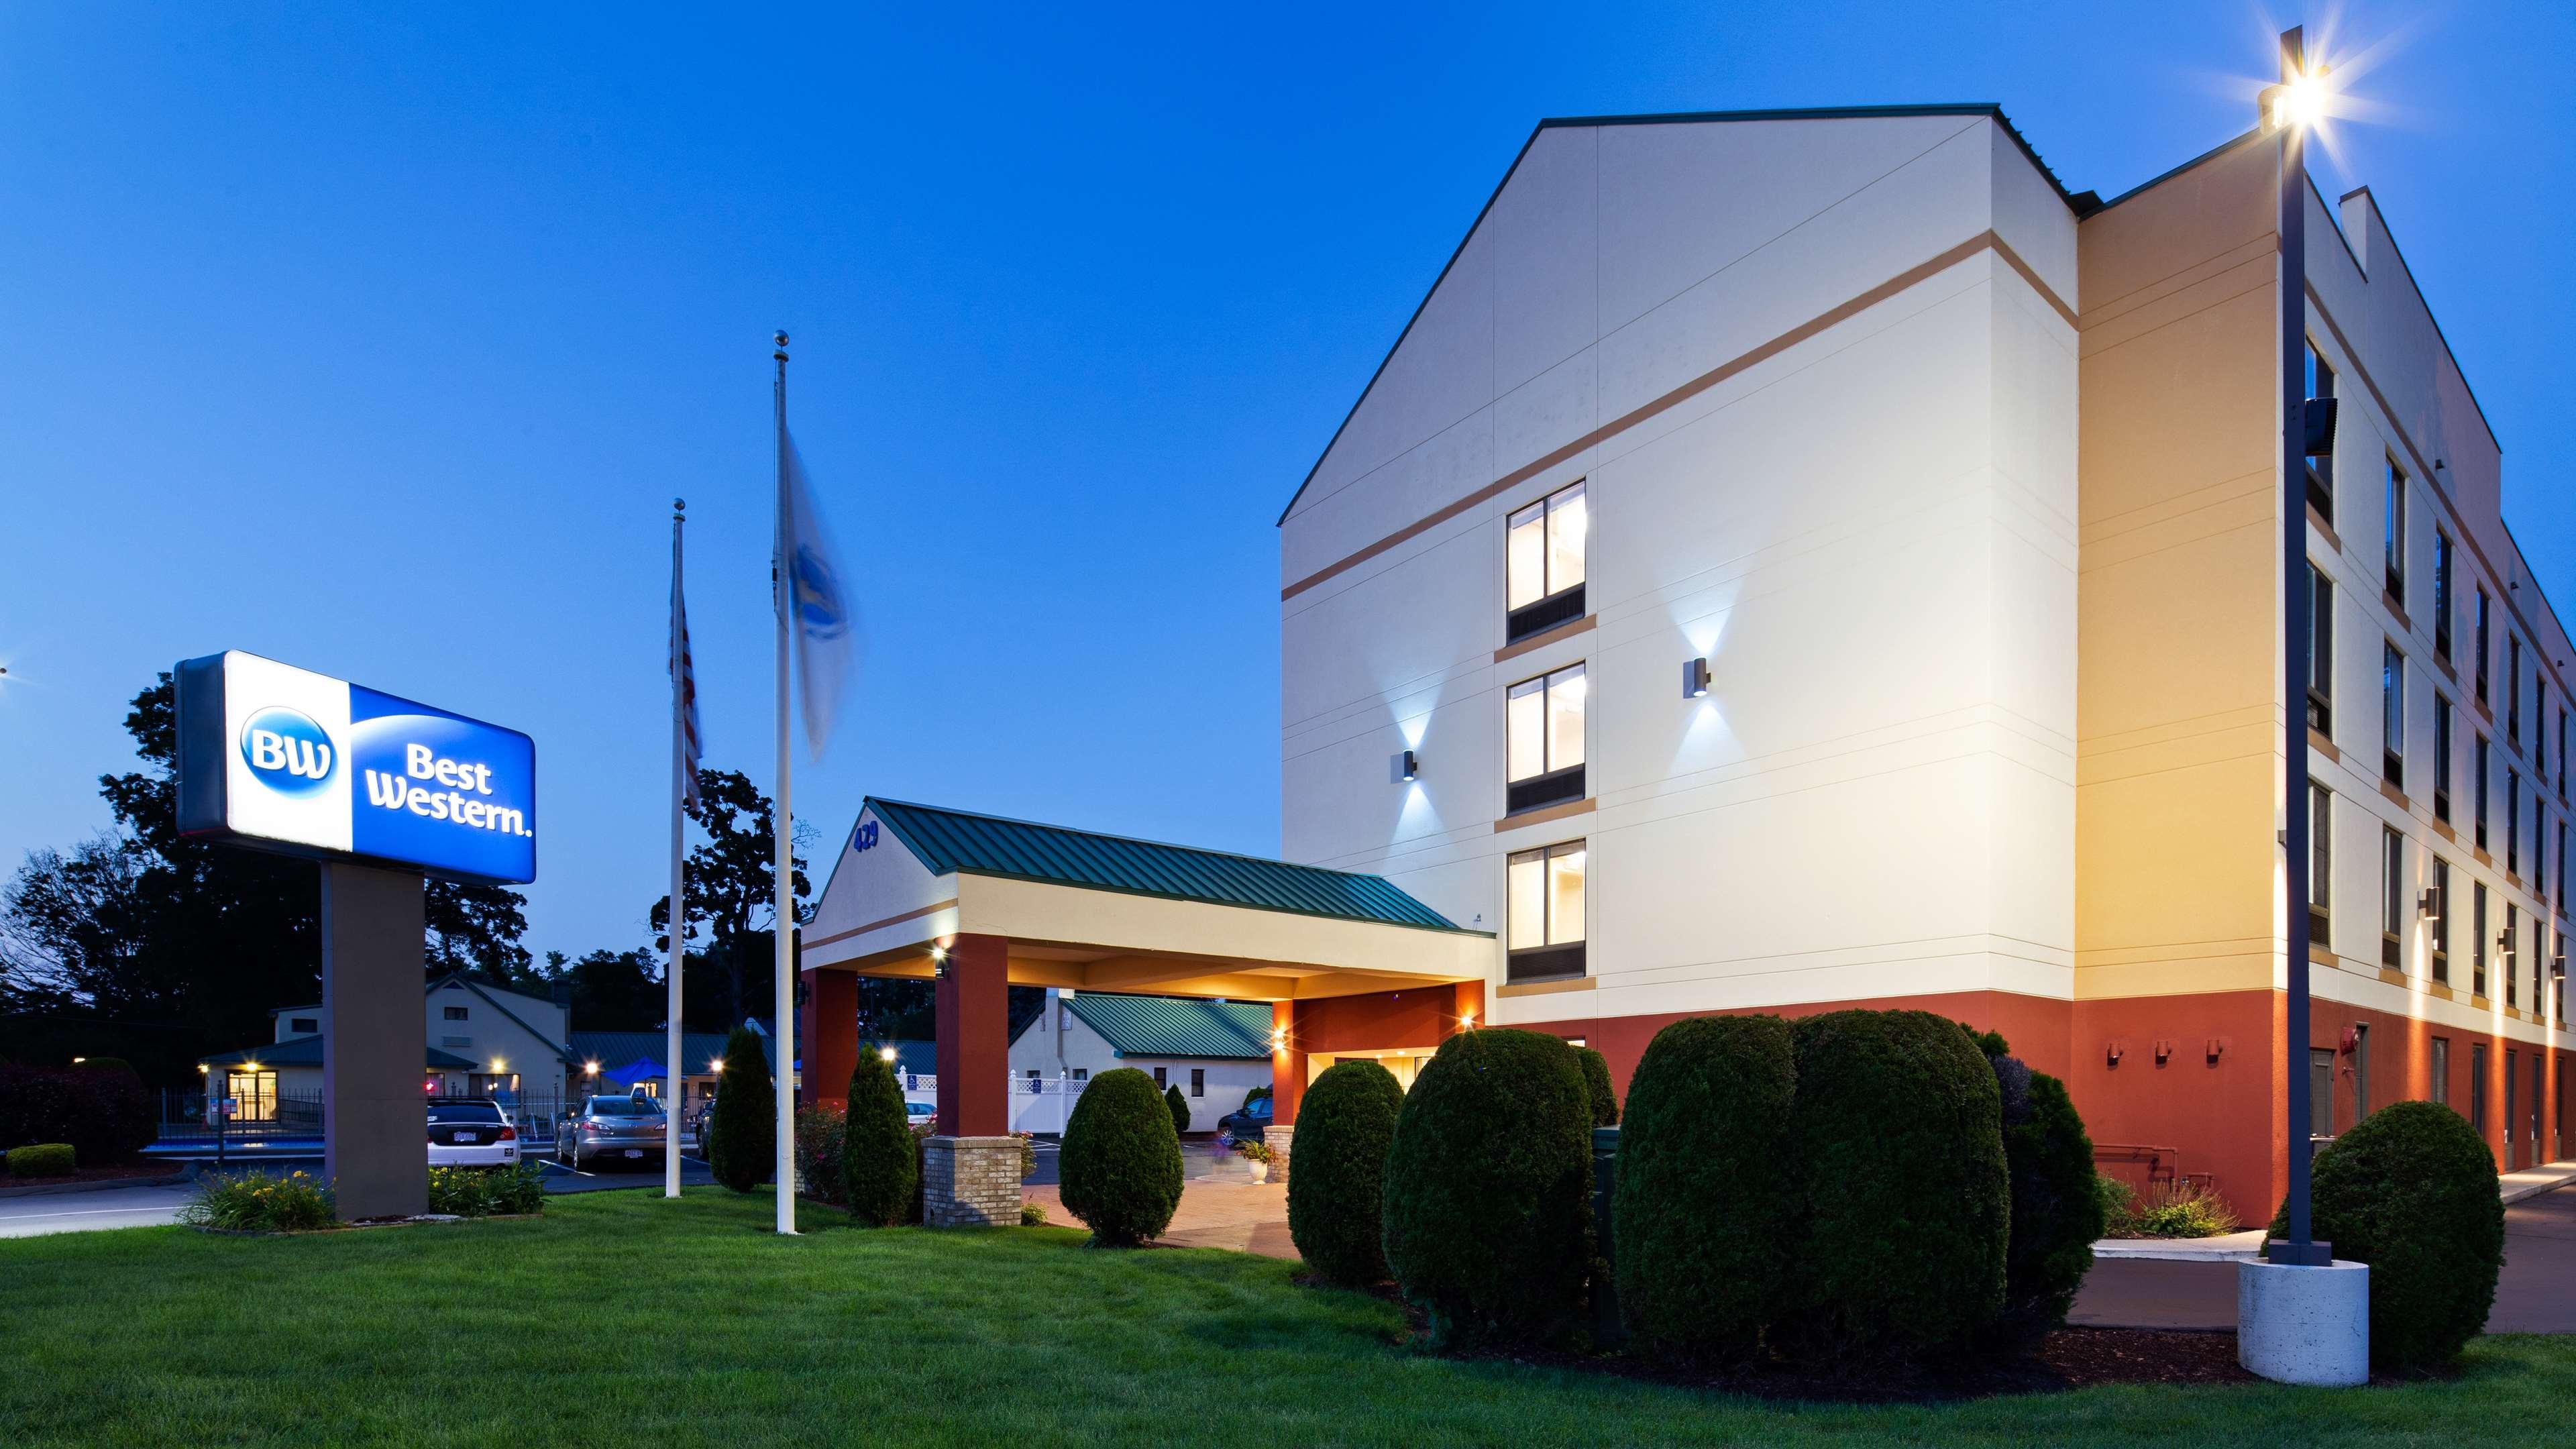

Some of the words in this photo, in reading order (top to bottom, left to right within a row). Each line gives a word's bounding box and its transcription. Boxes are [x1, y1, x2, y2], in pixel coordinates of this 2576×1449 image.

[252, 730, 331, 780] BW
[407, 743, 492, 795] Best
[854, 820, 879, 852] 429
